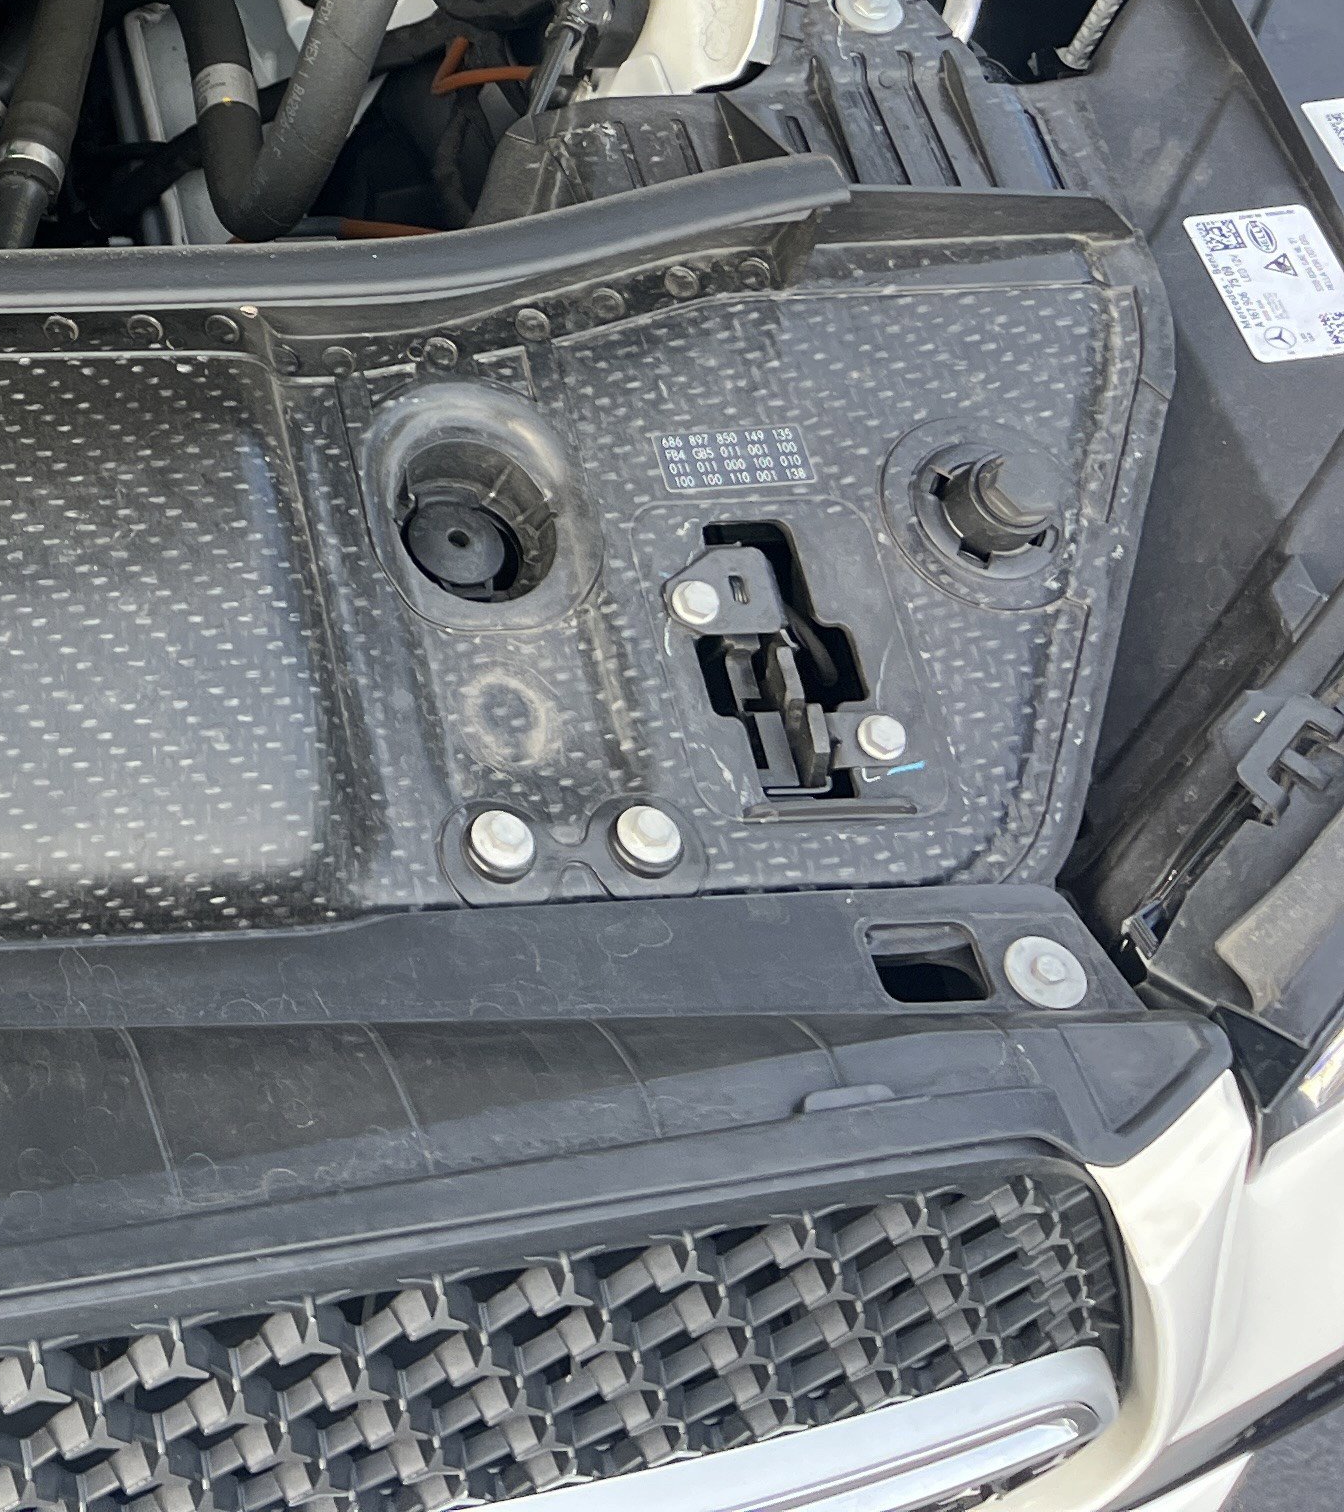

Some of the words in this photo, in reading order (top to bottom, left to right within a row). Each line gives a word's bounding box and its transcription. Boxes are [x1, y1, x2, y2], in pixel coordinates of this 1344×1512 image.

[1205, 253, 1221, 274] Benz
[1223, 284, 1252, 329] Mercedes
[661, 436, 683, 448] 686
[688, 433, 708, 446] 897
[715, 432, 737, 444] 850
[744, 430, 764, 441] 149
[771, 427, 793, 440] 135
[719, 445, 741, 457] 011
[747, 443, 768, 456] 001
[776, 441, 797, 453] 100
[669, 462, 690, 475] 011
[696, 460, 717, 473] 011
[723, 458, 746, 470] 000
[753, 456, 774, 468] 100
[779, 454, 801, 467] 010
[674, 475, 695, 488] 100
[702, 473, 723, 485] 100
[729, 471, 750, 483] 110
[756, 470, 778, 482] 001
[785, 467, 806, 479] 138
